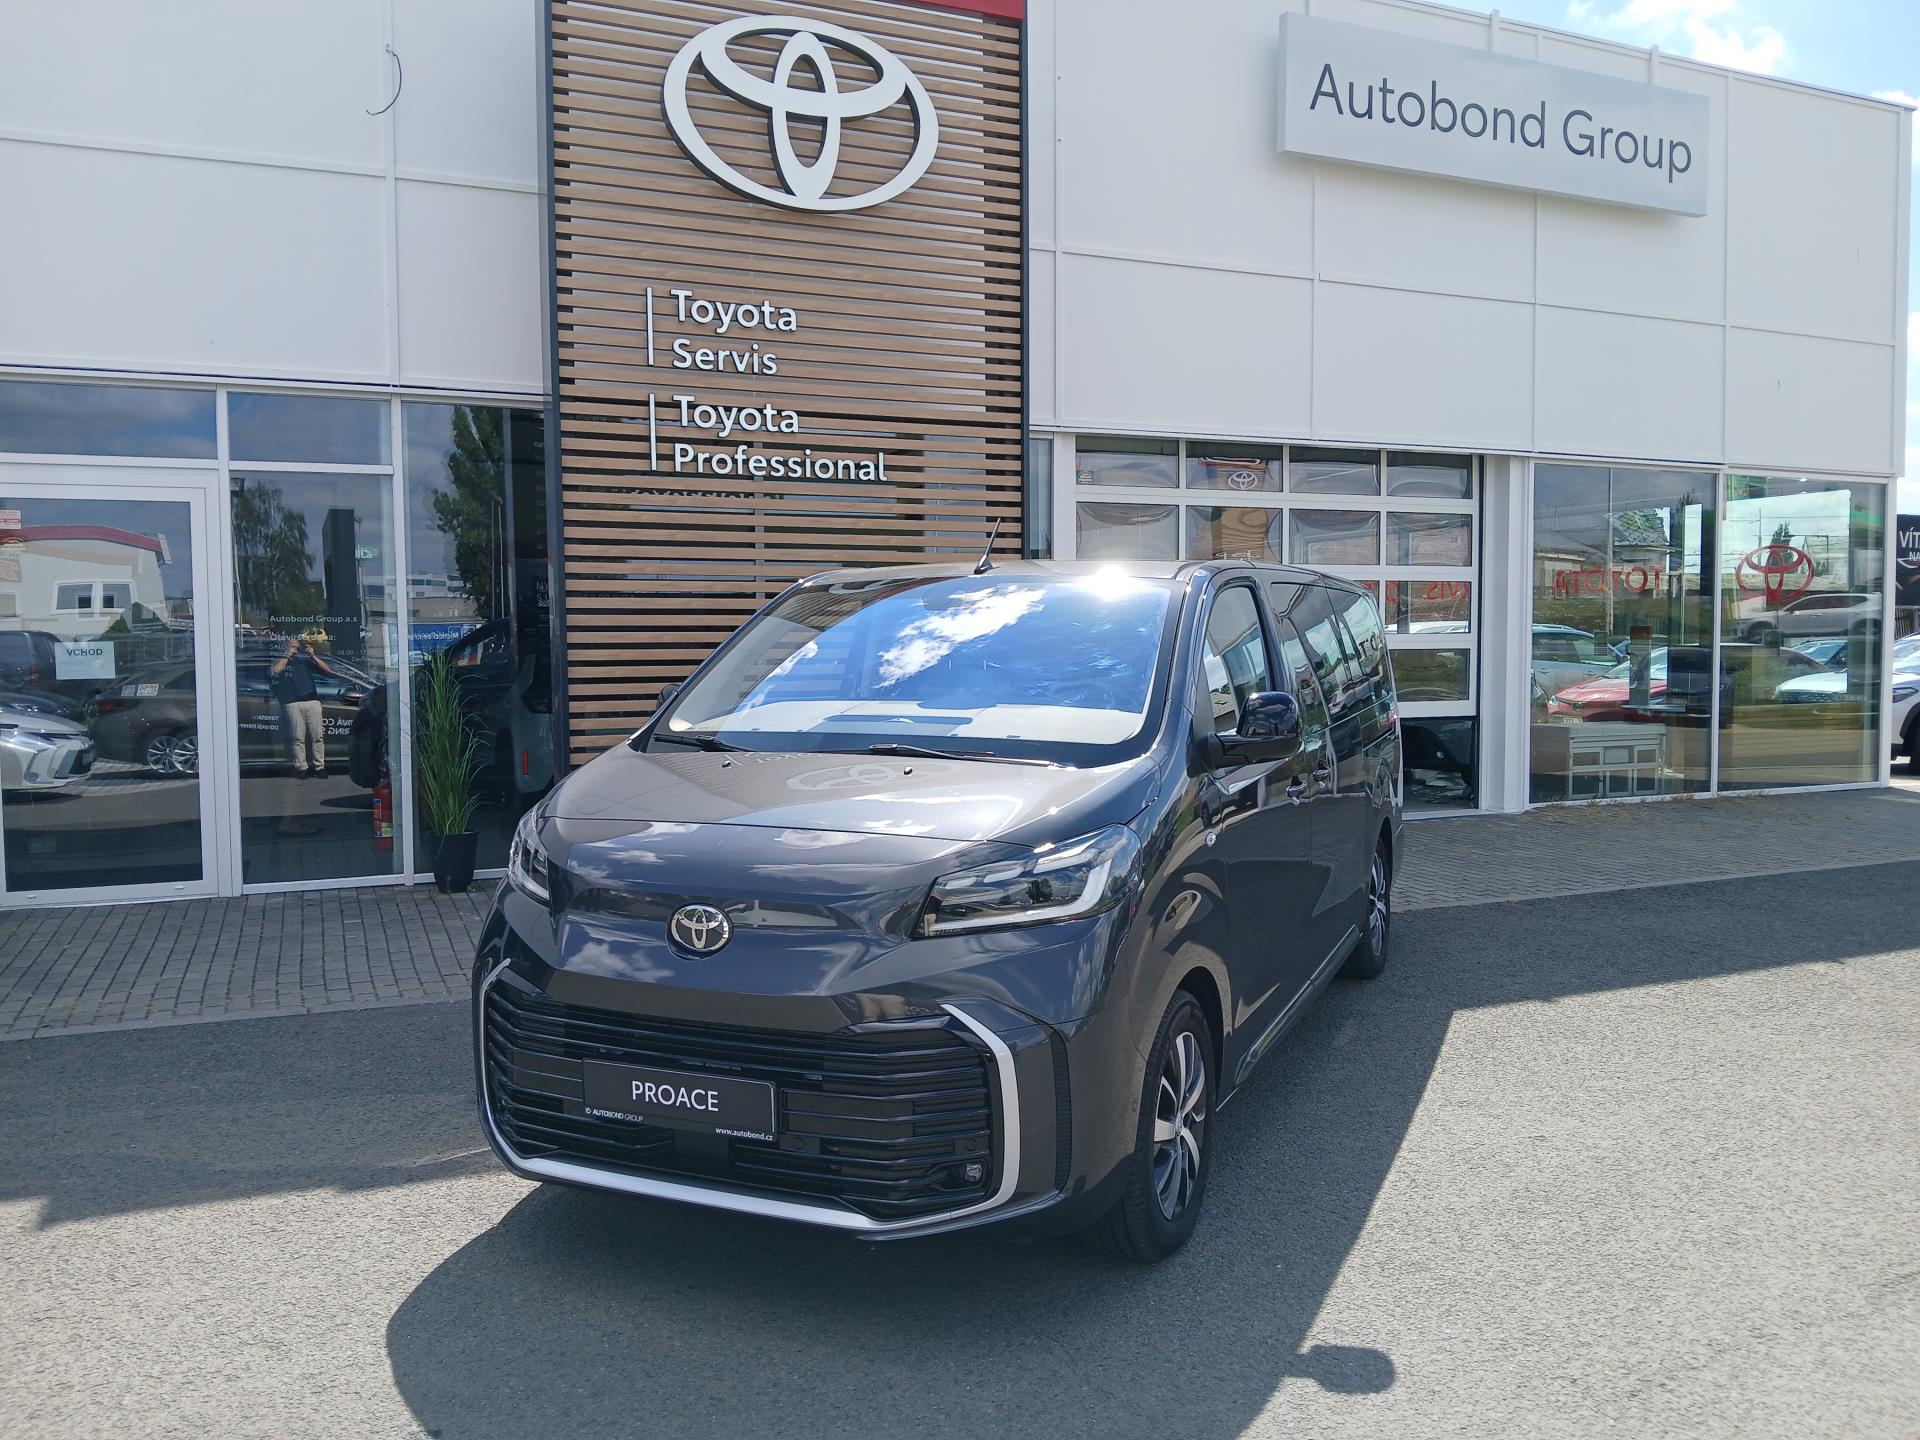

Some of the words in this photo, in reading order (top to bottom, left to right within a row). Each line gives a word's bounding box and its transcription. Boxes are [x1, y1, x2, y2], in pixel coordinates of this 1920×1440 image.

[1310, 63, 1546, 149] Autobond
[1562, 109, 1692, 183] Group
[670, 288, 798, 334] Toyota
[672, 338, 778, 375] Servis
[672, 394, 800, 437] Toyota
[673, 443, 888, 482] Professional
[1899, 527, 1920, 548] VÍT
[269, 614, 314, 623] Autobond
[315, 615, 344, 624] Group
[66, 648, 103, 657] VCHOD
[631, 1080, 720, 1112] PROACE
[592, 1108, 625, 1120] AUTOBOND
[624, 1112, 643, 1122] GROUP
[715, 1127, 774, 1141] www.autobond.cz
